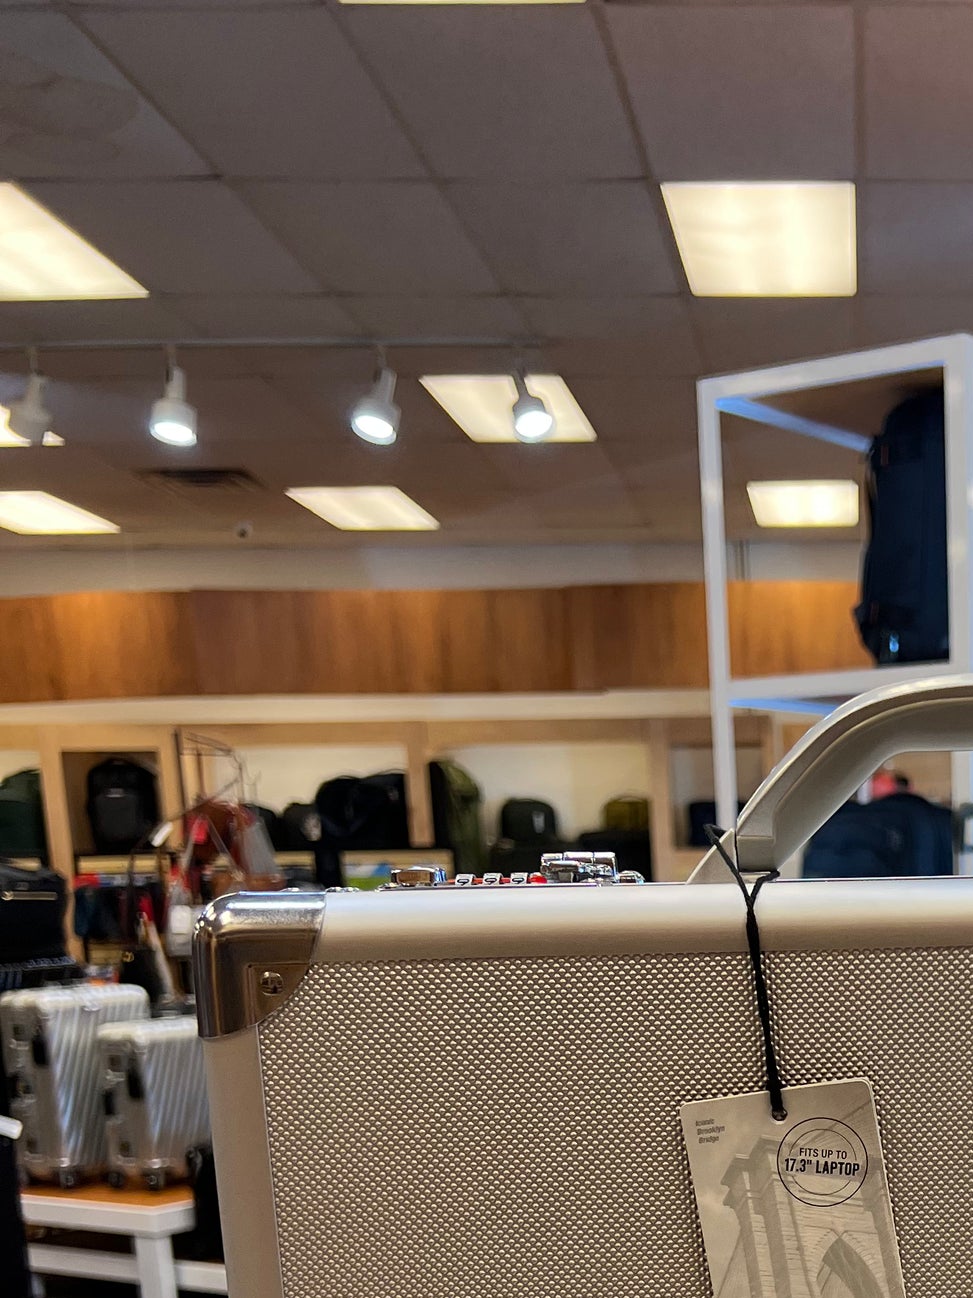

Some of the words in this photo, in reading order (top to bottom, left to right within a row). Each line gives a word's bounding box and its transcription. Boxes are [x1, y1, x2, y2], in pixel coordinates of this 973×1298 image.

[696, 1125, 726, 1135] Brooklyn
[698, 1135, 720, 1144] Bridge
[799, 1147, 819, 1158] FITS
[821, 1149, 833, 1159] UP
[836, 1150, 847, 1160] TO
[784, 1158, 812, 1172] 17.3"
[815, 1160, 860, 1176] LAPTOP
